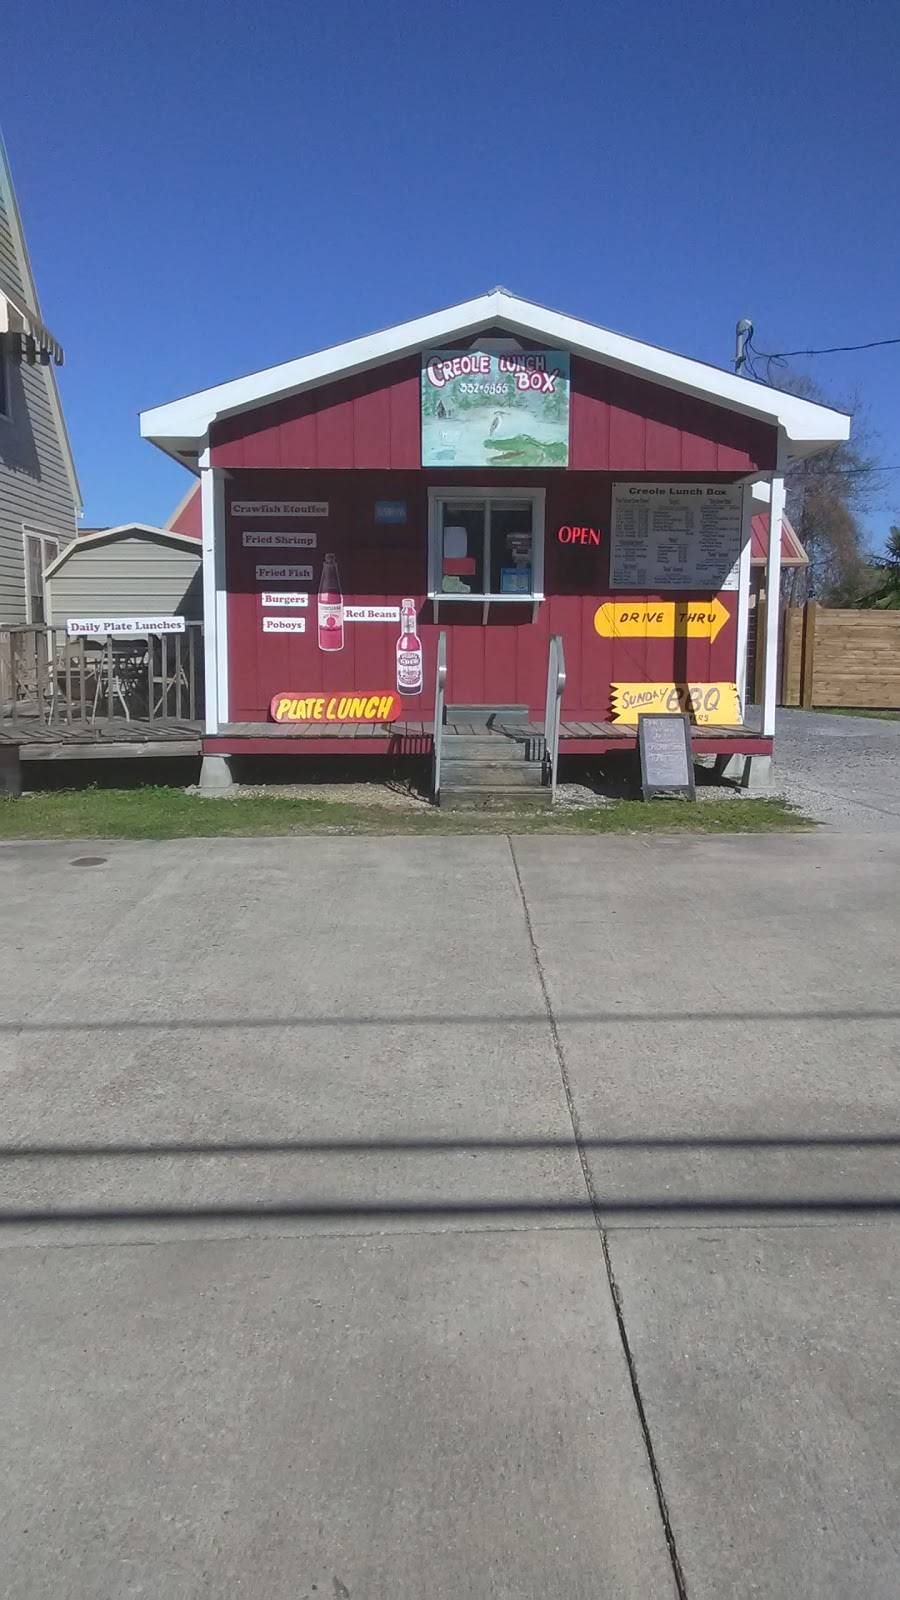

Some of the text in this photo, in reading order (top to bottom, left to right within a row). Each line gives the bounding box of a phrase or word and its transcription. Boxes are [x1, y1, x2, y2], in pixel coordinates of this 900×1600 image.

[427, 354, 546, 389] CREOLE LUNCH
[514, 369, 559, 393] BOX
[629, 487, 727, 496] Creole Lunch Box
[233, 504, 327, 514] Crawfish Etouffee
[245, 535, 314, 546] Fried Shrimp
[558, 525, 601, 545] OPEN
[258, 568, 311, 577] Fried Fish
[264, 595, 306, 604] Burgers
[346, 609, 365, 618] Red
[367, 609, 397, 618] Beans
[619, 612, 717, 624] DRIVE THRU
[70, 621, 182, 632] Daily Plate Lunches
[266, 620, 302, 630] Poboys
[622, 687, 721, 712] SUNDAY BBQ
[276, 696, 394, 720] PLATE LUNCH
